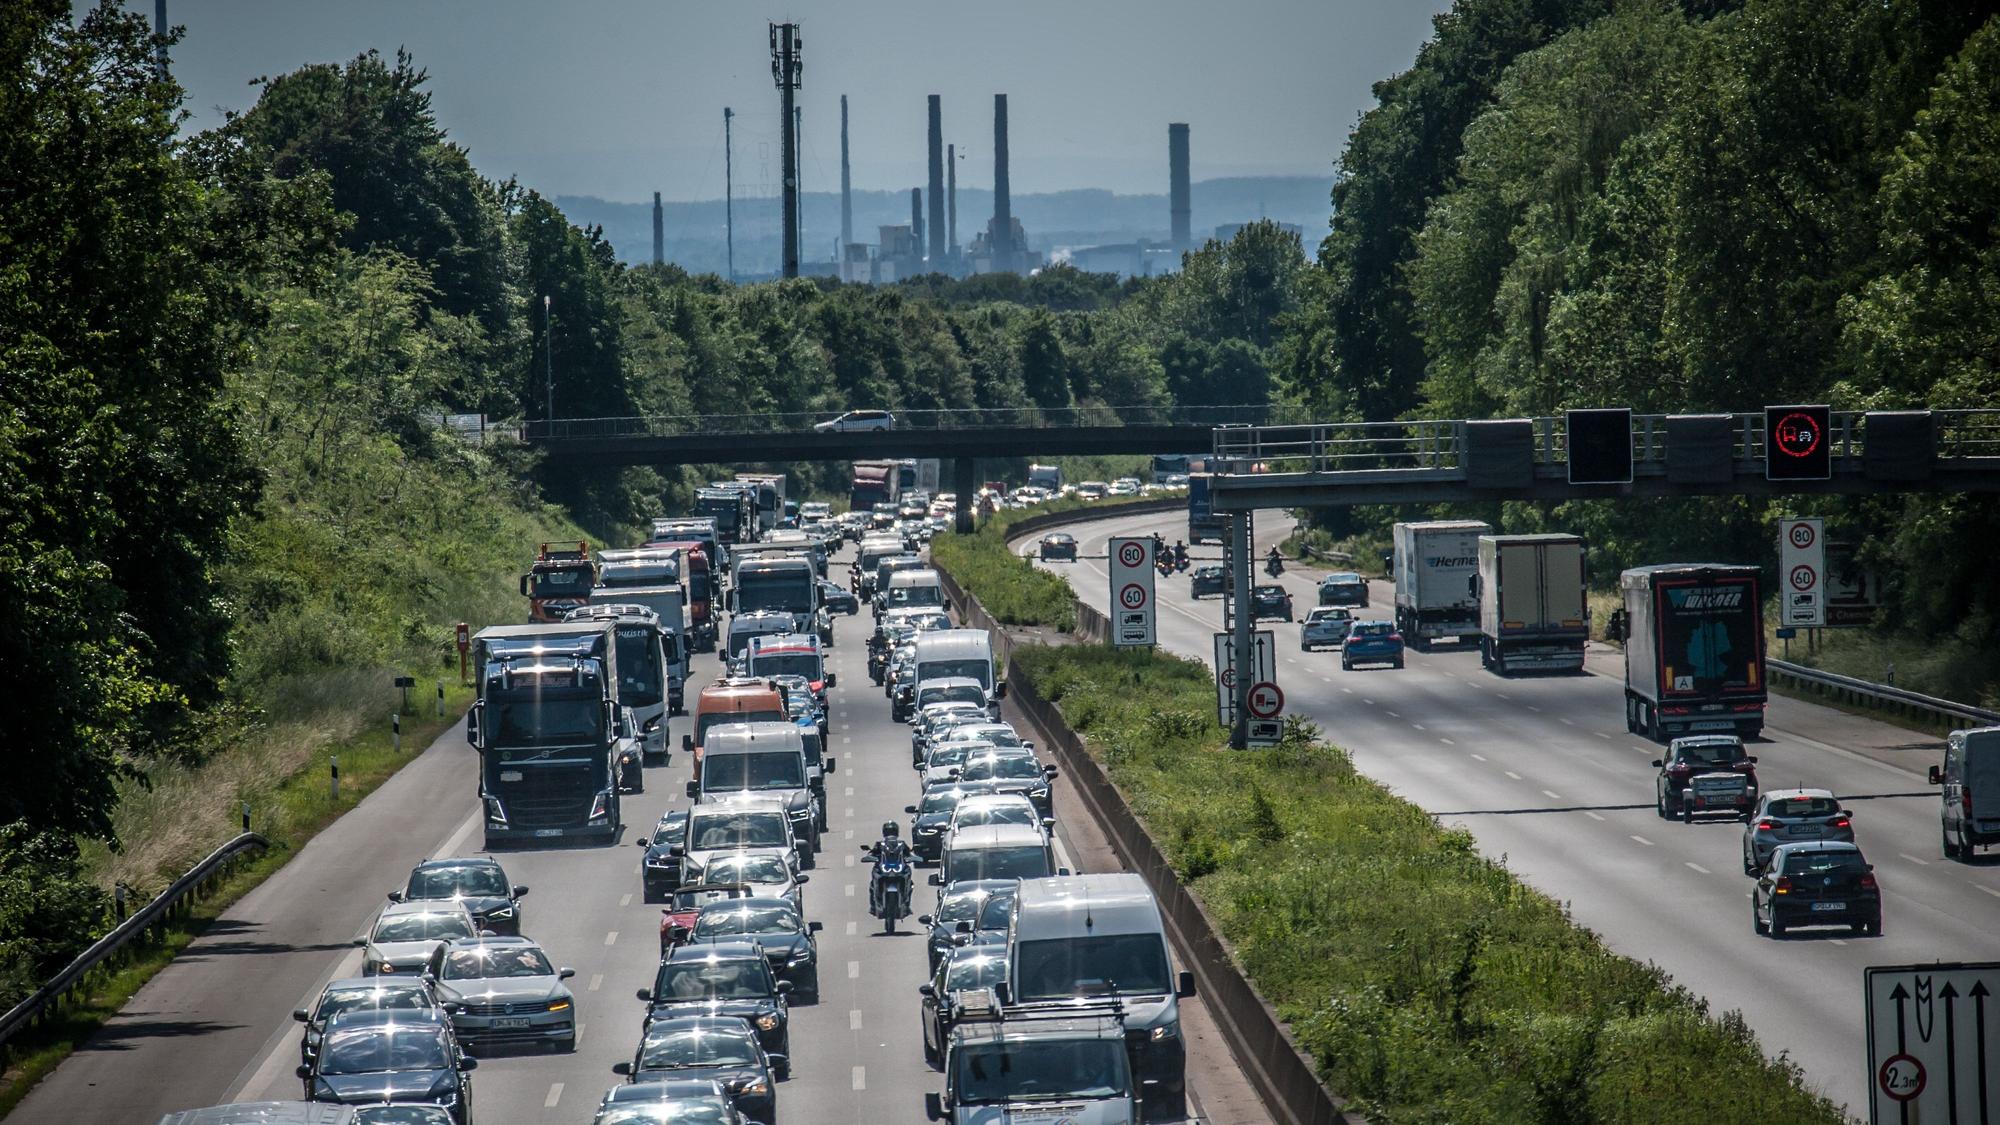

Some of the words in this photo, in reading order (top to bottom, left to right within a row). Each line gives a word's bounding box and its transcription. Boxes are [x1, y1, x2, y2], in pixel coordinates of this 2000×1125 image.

[1794, 530, 1810, 542] 80
[1124, 548, 1140, 561] 80
[1795, 571, 1811, 584] 60
[1126, 590, 1141, 603] 60
[1679, 677, 1689, 690] A
